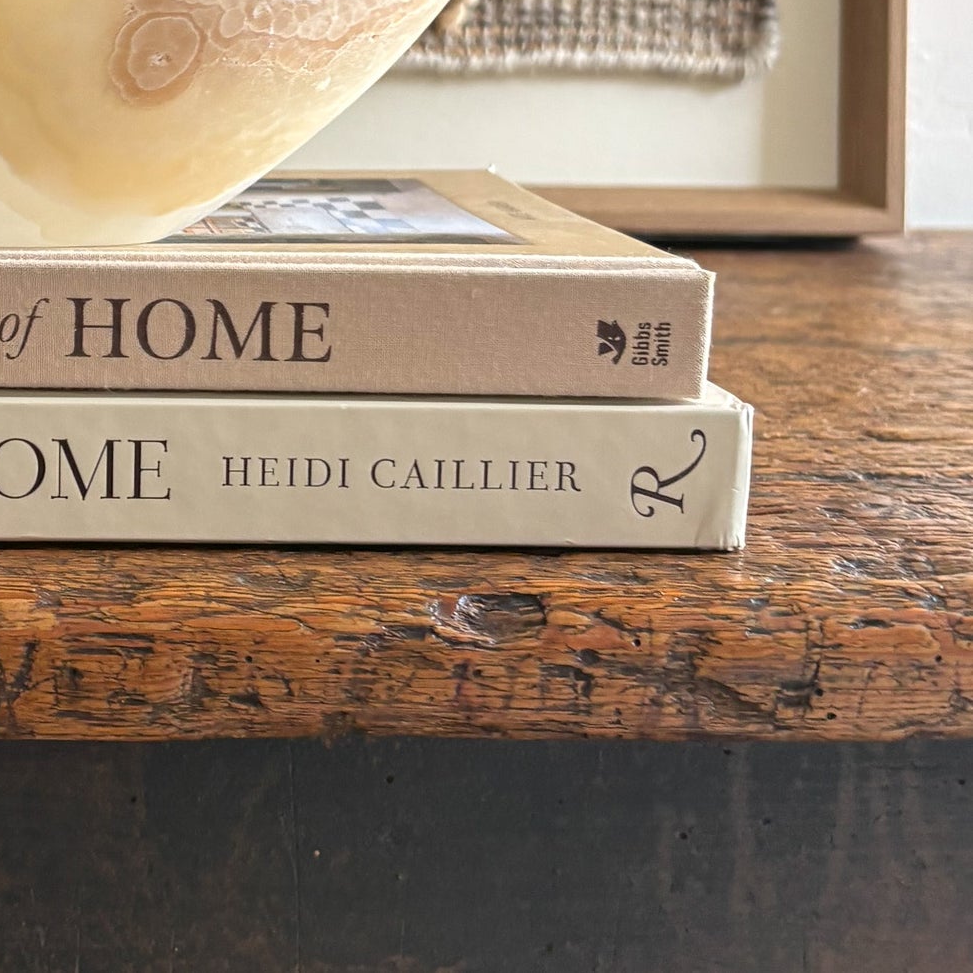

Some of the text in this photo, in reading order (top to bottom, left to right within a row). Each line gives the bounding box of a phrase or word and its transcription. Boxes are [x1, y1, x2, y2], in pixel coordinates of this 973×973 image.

[65, 298, 333, 363] HOME
[627, 322, 652, 366] Gibbs
[651, 322, 672, 367] Smith
[222, 456, 582, 493] HEIDI CAILLIER
[631, 429, 707, 518] R
